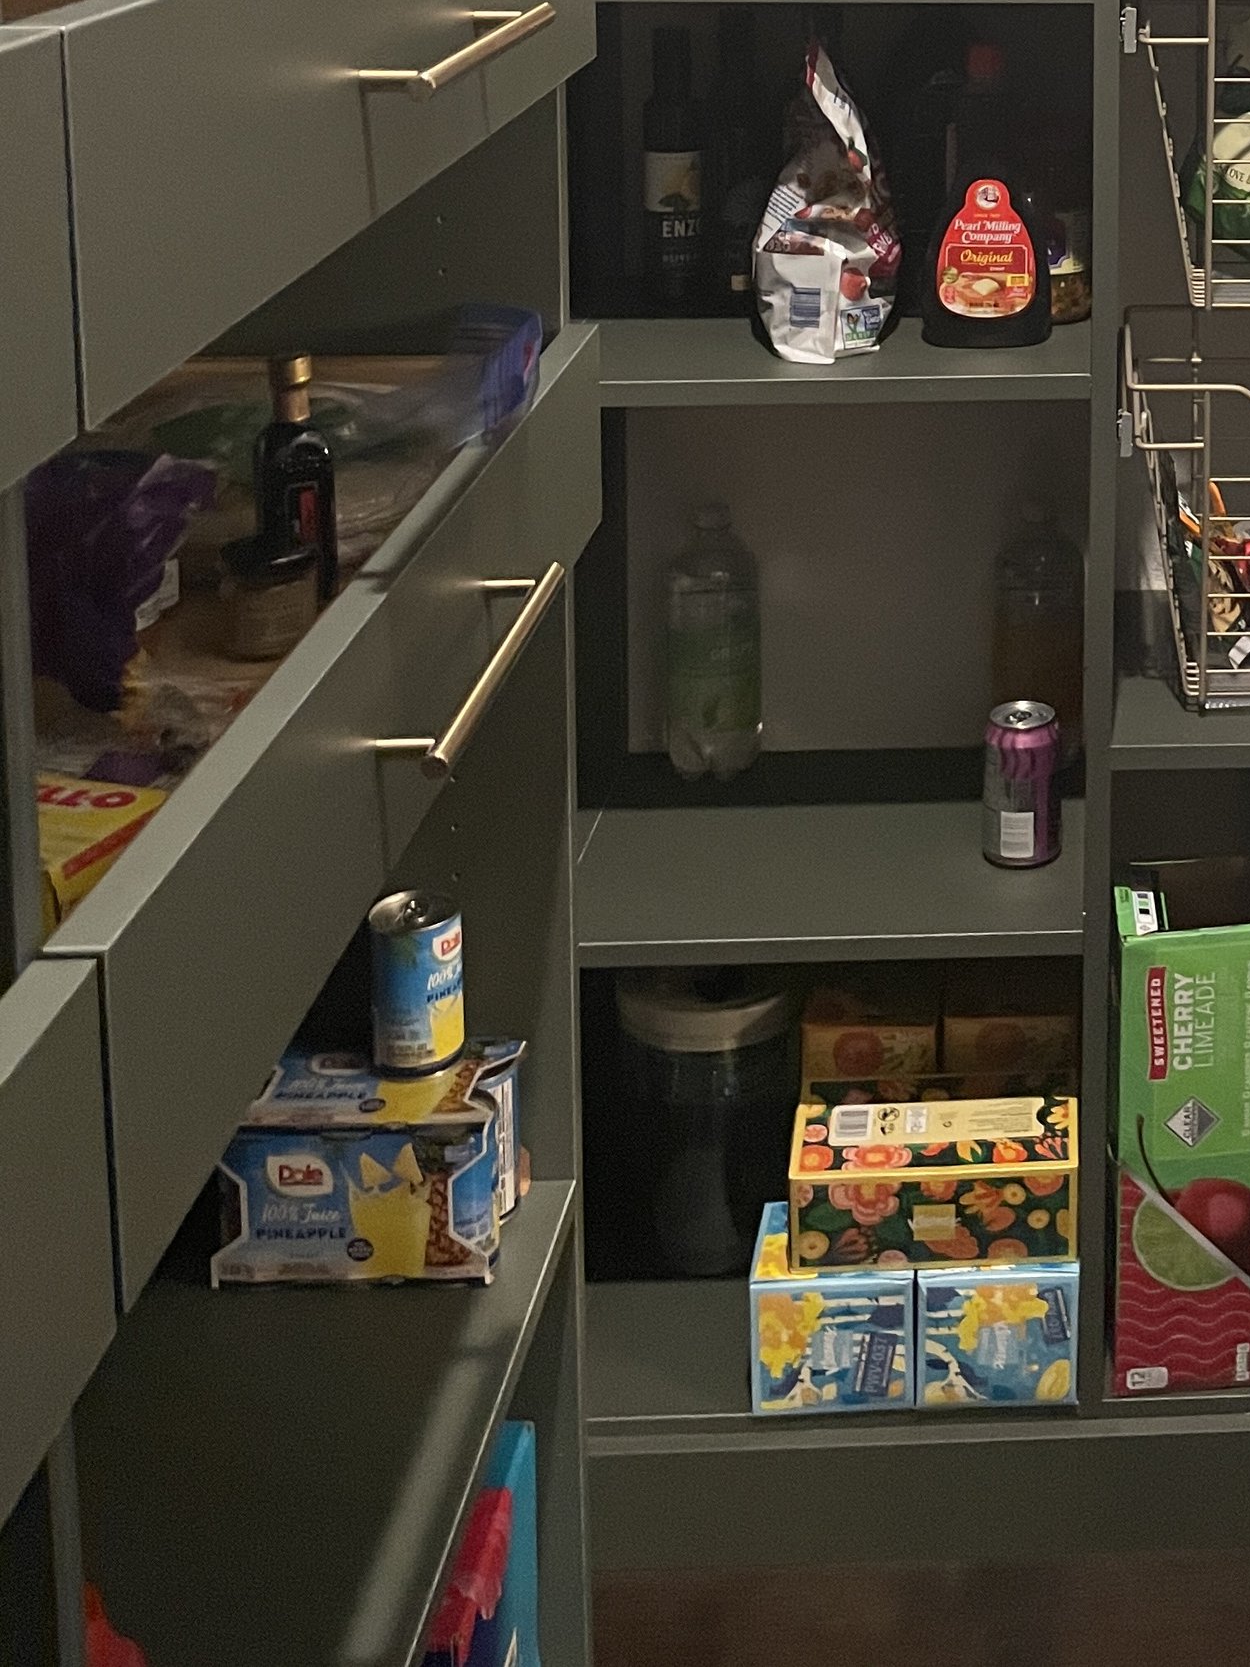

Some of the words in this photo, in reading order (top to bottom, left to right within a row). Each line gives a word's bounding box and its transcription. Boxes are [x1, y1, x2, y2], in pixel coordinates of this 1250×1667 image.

[954, 218, 981, 231] Pearl
[983, 219, 1021, 234] Milling
[961, 231, 1013, 244] Company
[960, 248, 1013, 266] Original
[1150, 977, 1165, 1066] SWEETENED
[1172, 972, 1195, 1071] CHERRY
[1193, 971, 1217, 1069] LIMEADE
[274, 1091, 367, 1100] PINEAPPLE
[278, 1164, 323, 1186] Dole
[262, 1203, 298, 1223] 100%
[302, 1204, 341, 1222] Juice
[256, 1227, 347, 1240] PINEAPPLE
[864, 1335, 887, 1394] PWV-037
[1131, 1371, 1146, 1387] 12
